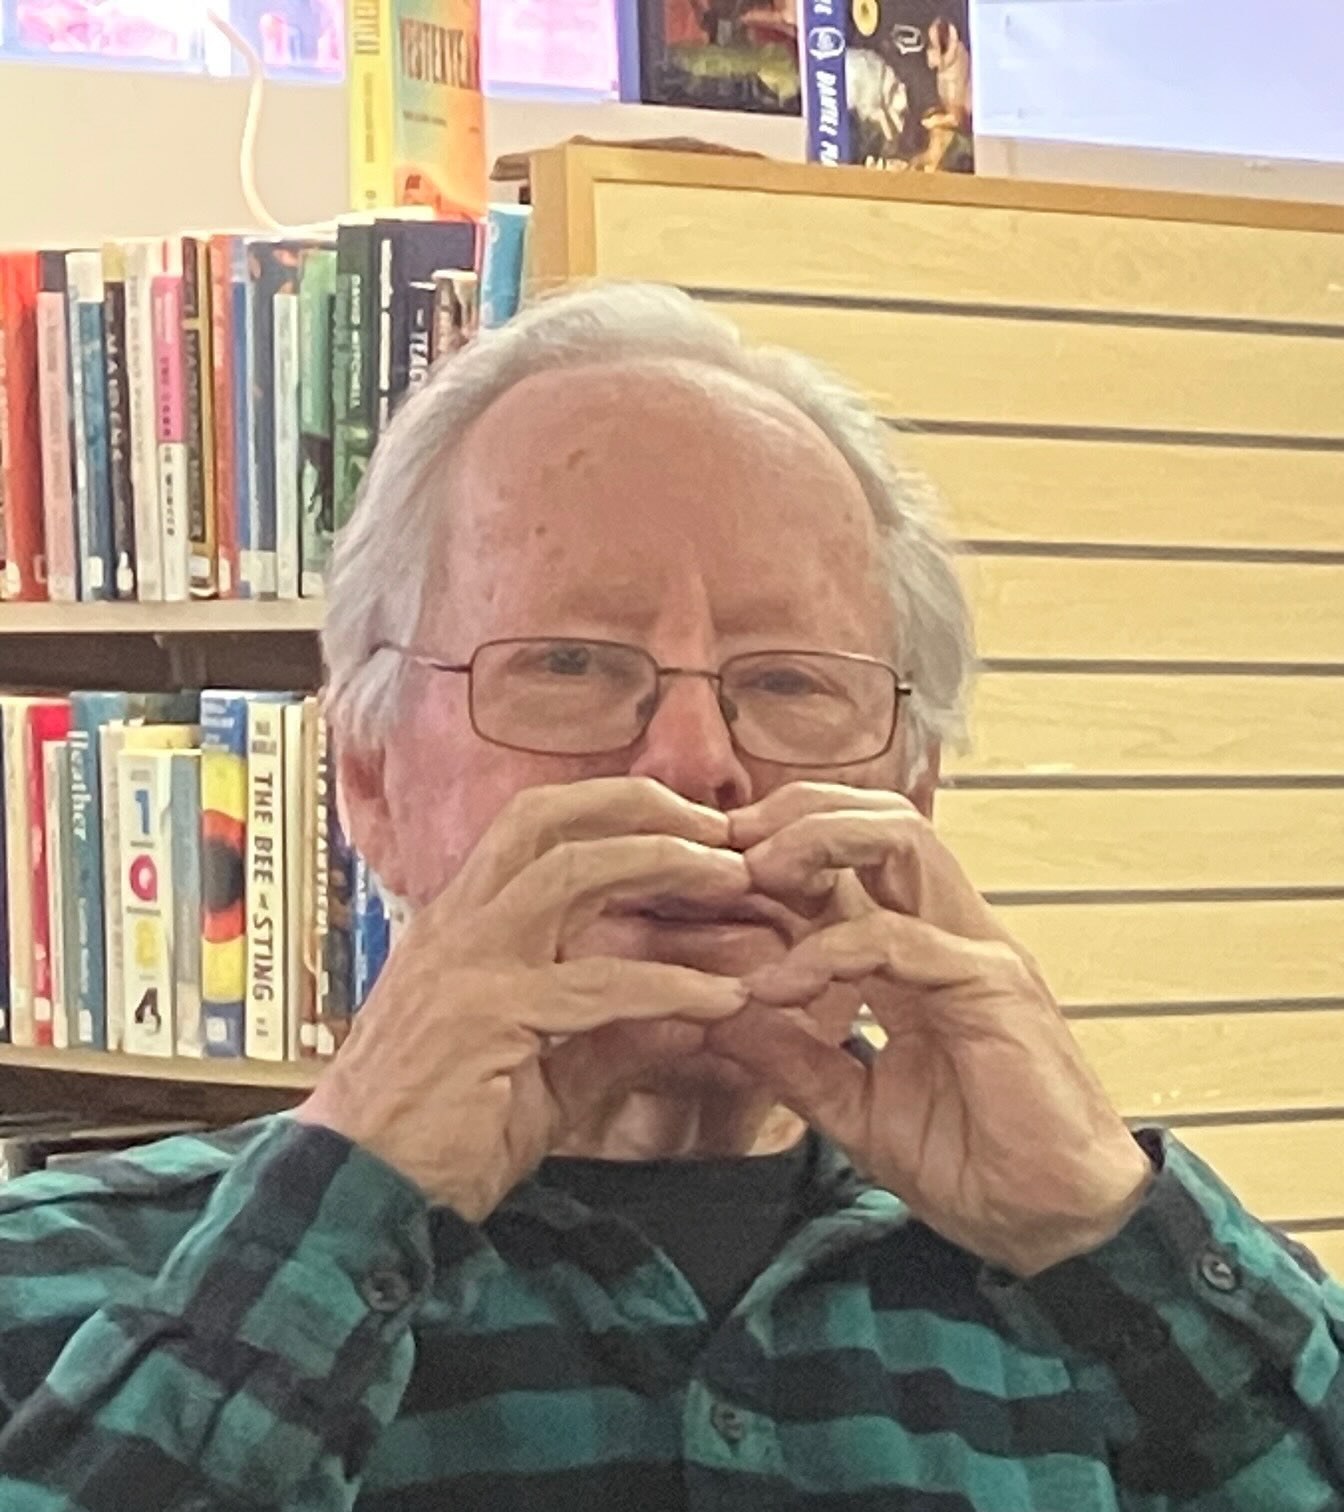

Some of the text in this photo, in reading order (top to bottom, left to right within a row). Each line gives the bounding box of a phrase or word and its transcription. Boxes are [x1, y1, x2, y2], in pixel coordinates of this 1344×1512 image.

[68, 730, 91, 842] Heather
[254, 773, 274, 824] THE
[254, 834, 274, 884] BEE
[253, 914, 275, 1002] STING
